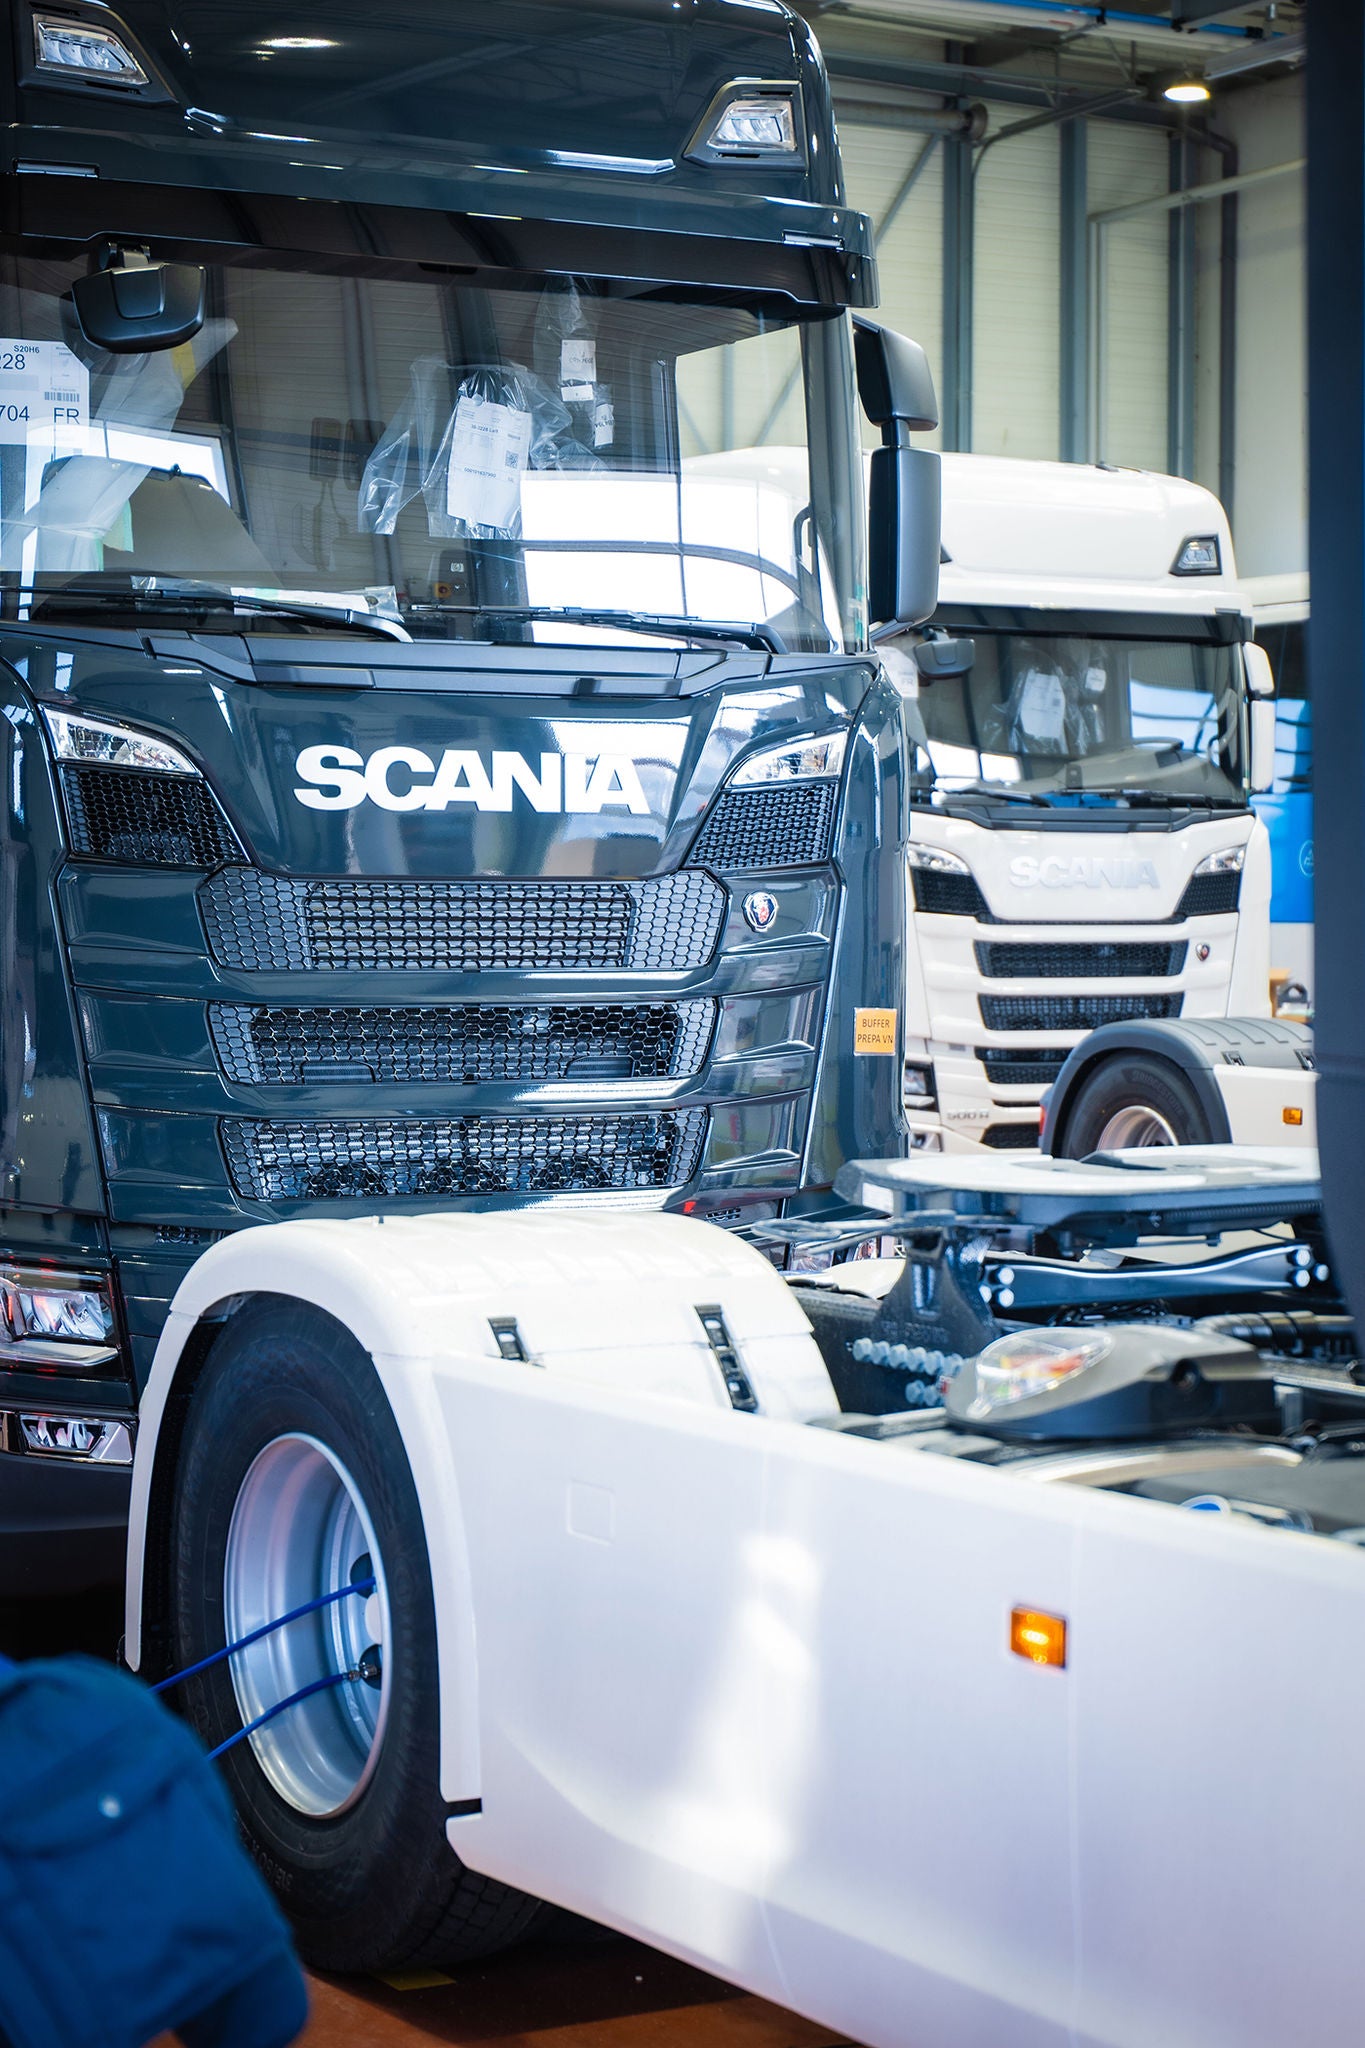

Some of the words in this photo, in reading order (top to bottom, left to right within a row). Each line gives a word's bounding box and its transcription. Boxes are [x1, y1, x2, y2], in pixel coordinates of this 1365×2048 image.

[14, 345, 40, 354] S20H6
[0, 353, 26, 370] 28
[53, 407, 80, 425] FR
[293, 744, 651, 815] SCANIA
[1009, 855, 1160, 889] SCANIA
[862, 1018, 890, 1028] BUFFER
[857, 1034, 881, 1043] PREPA
[882, 1035, 894, 1044] VN
